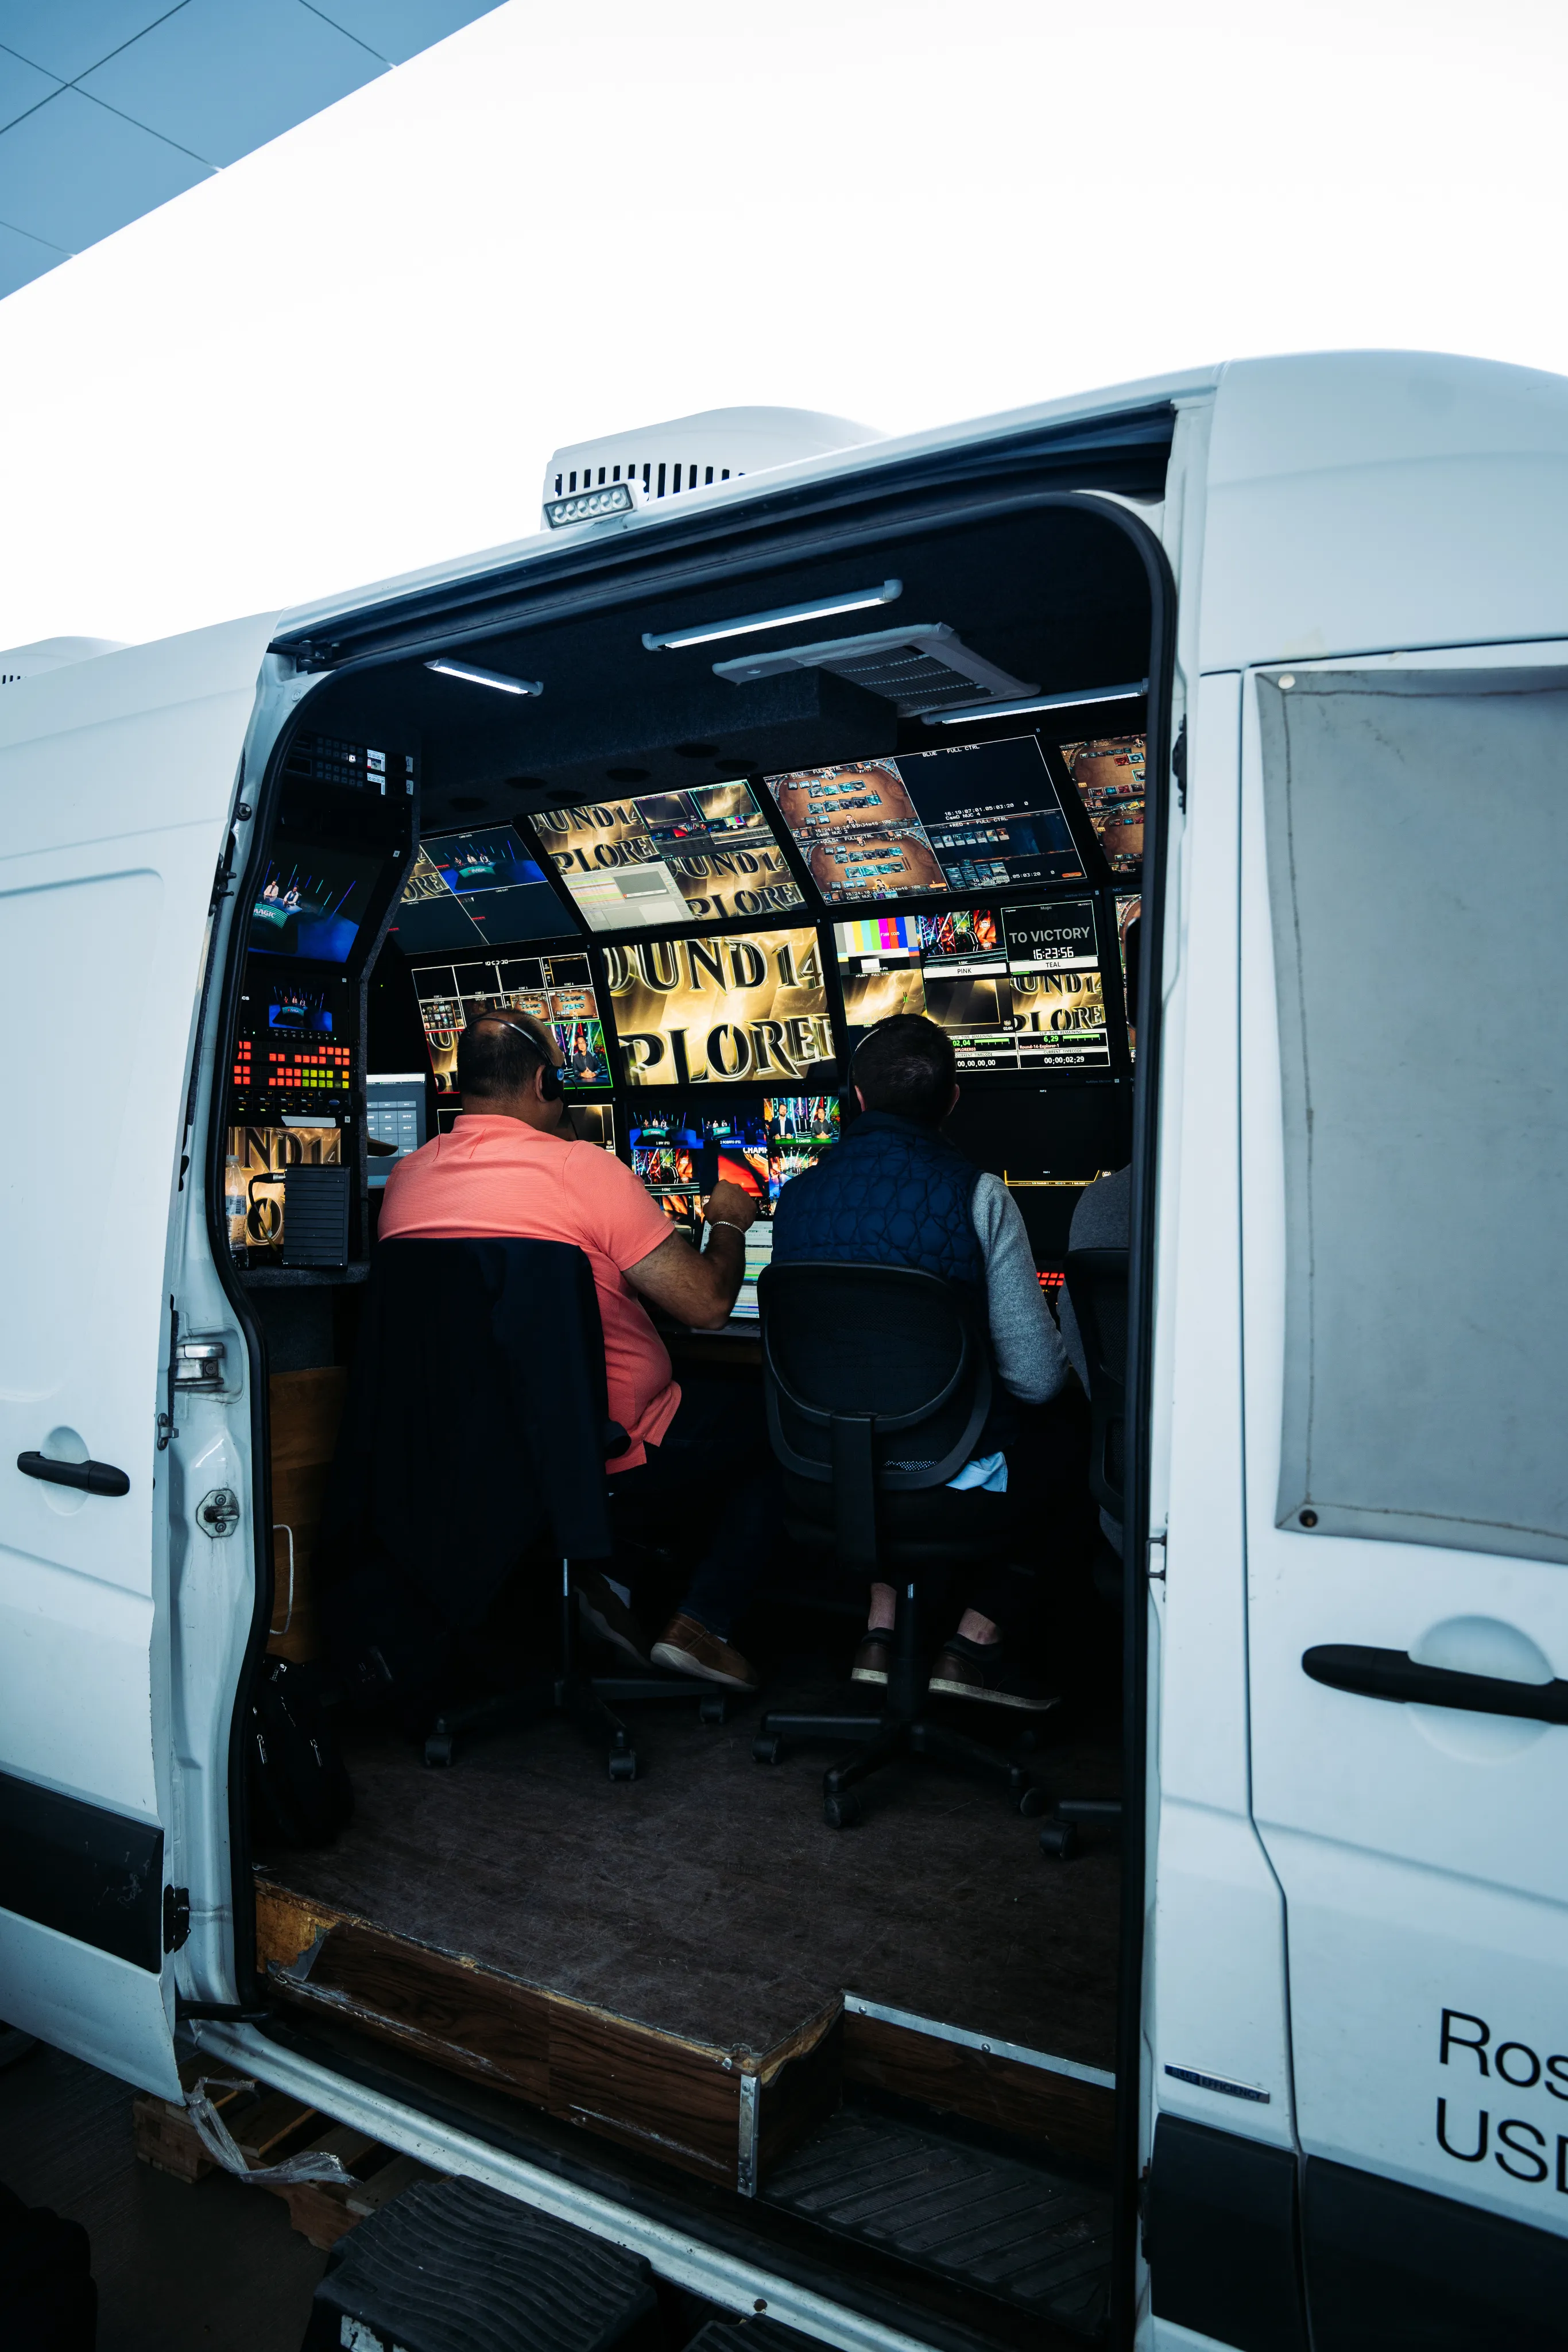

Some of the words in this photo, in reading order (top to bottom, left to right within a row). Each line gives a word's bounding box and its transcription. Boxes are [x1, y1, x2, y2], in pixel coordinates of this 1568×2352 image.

[1009, 931, 1028, 944] TO
[1030, 927, 1090, 942] VICTORY
[1033, 946, 1074, 960] 16:23:56
[1439, 2007, 1568, 2102] Ros
[1201, 2074, 1262, 2101] EFFICIENCY
[1436, 2096, 1568, 2195] US
